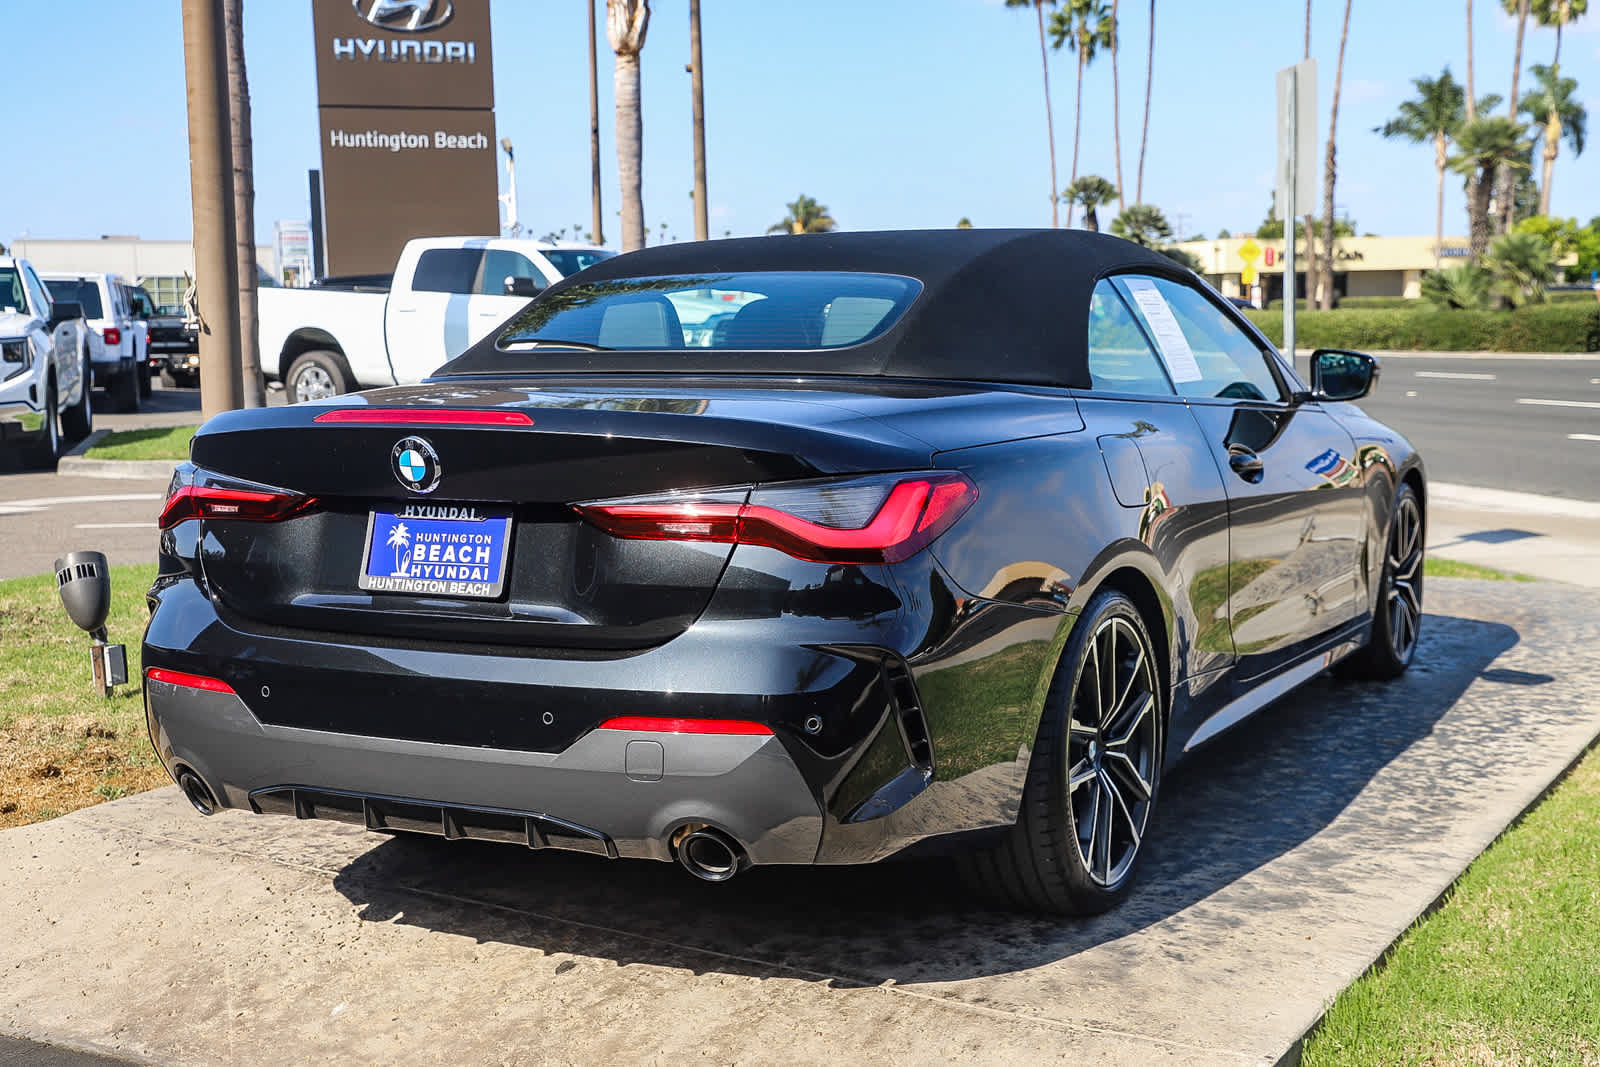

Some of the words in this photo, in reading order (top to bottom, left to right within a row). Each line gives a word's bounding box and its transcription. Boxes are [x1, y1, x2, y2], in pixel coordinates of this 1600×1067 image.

[333, 38, 476, 63] HYUNDAI
[330, 129, 429, 151] Huntington
[434, 131, 488, 149] Beach
[405, 505, 475, 519] HYUNDAI
[415, 532, 492, 544] HUNTINGTON
[413, 544, 490, 564] BEACH
[411, 564, 488, 581] HYUNDAI
[368, 577, 447, 593] HUNTINGTON
[449, 581, 491, 595] BEACH
